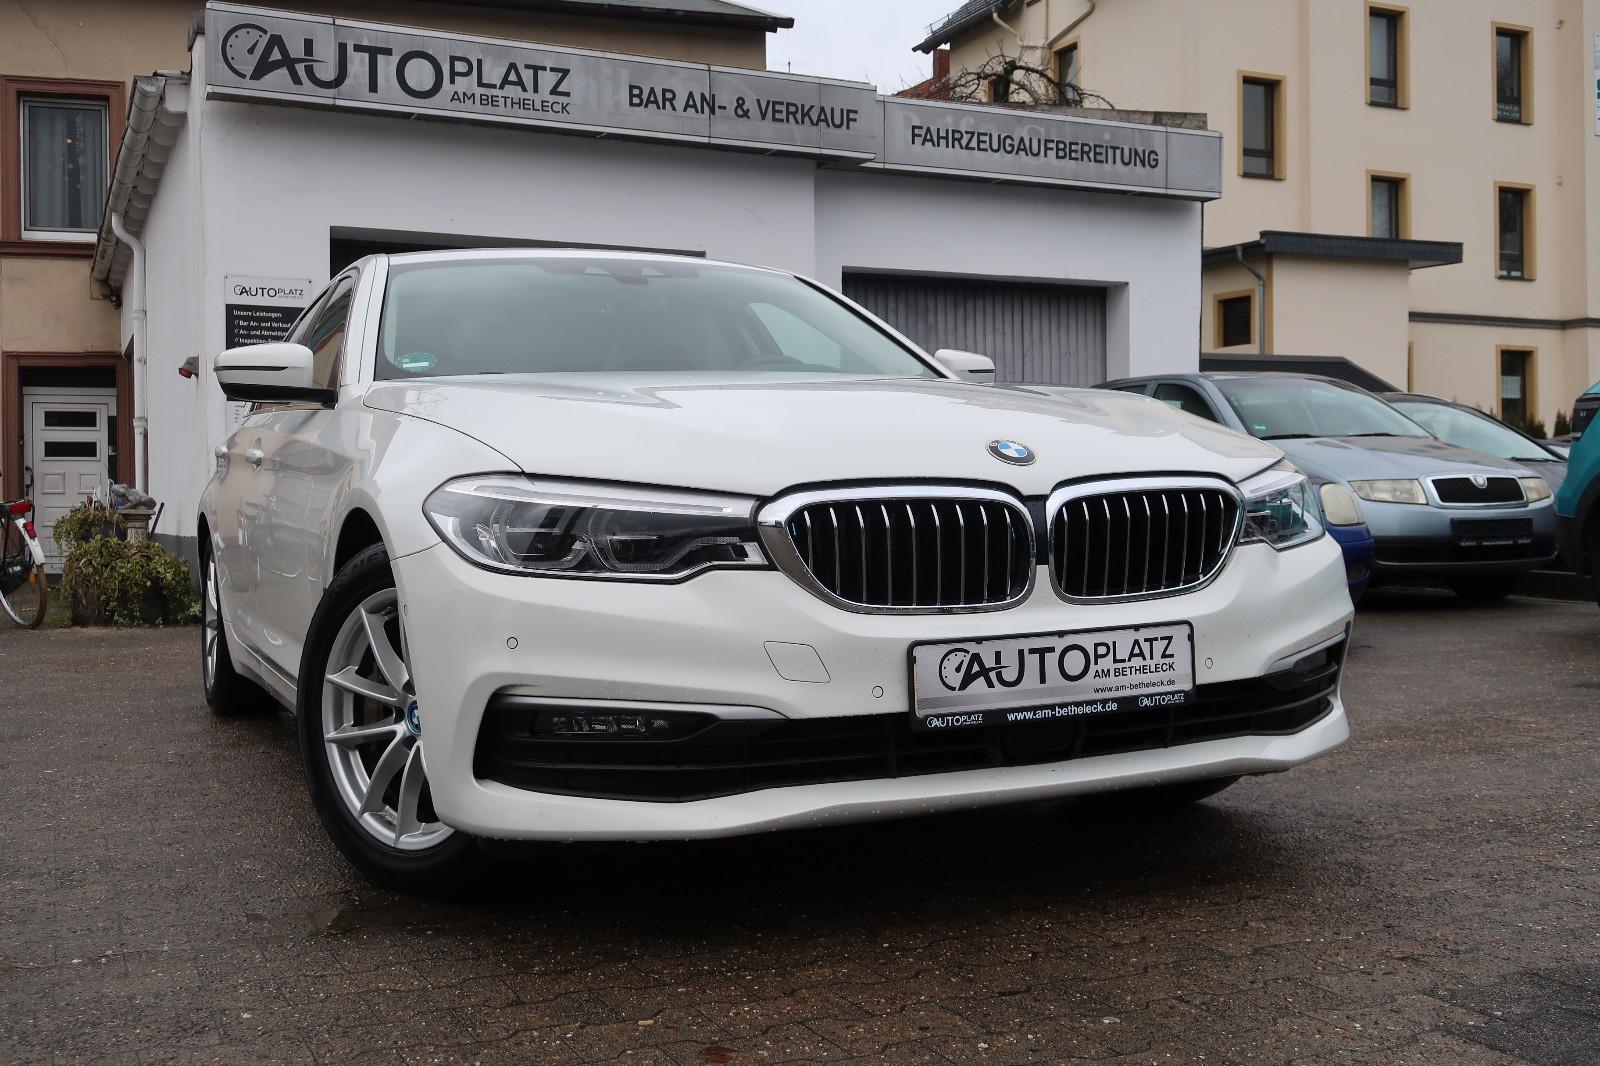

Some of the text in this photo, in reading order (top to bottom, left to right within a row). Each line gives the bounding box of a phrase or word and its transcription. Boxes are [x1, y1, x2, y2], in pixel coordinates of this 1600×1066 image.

[450, 91, 571, 115] AM BETHELECK
[628, 84, 859, 130] BAR AN- & VERKAUF
[910, 124, 1160, 170] FAHRZEUGAUFBEREITUNG
[1093, 662, 1175, 679] AM BETHELECK
[1093, 679, 1176, 694] www.am-betheleck.de
[1007, 701, 1118, 721] www.am-betheleck.de
